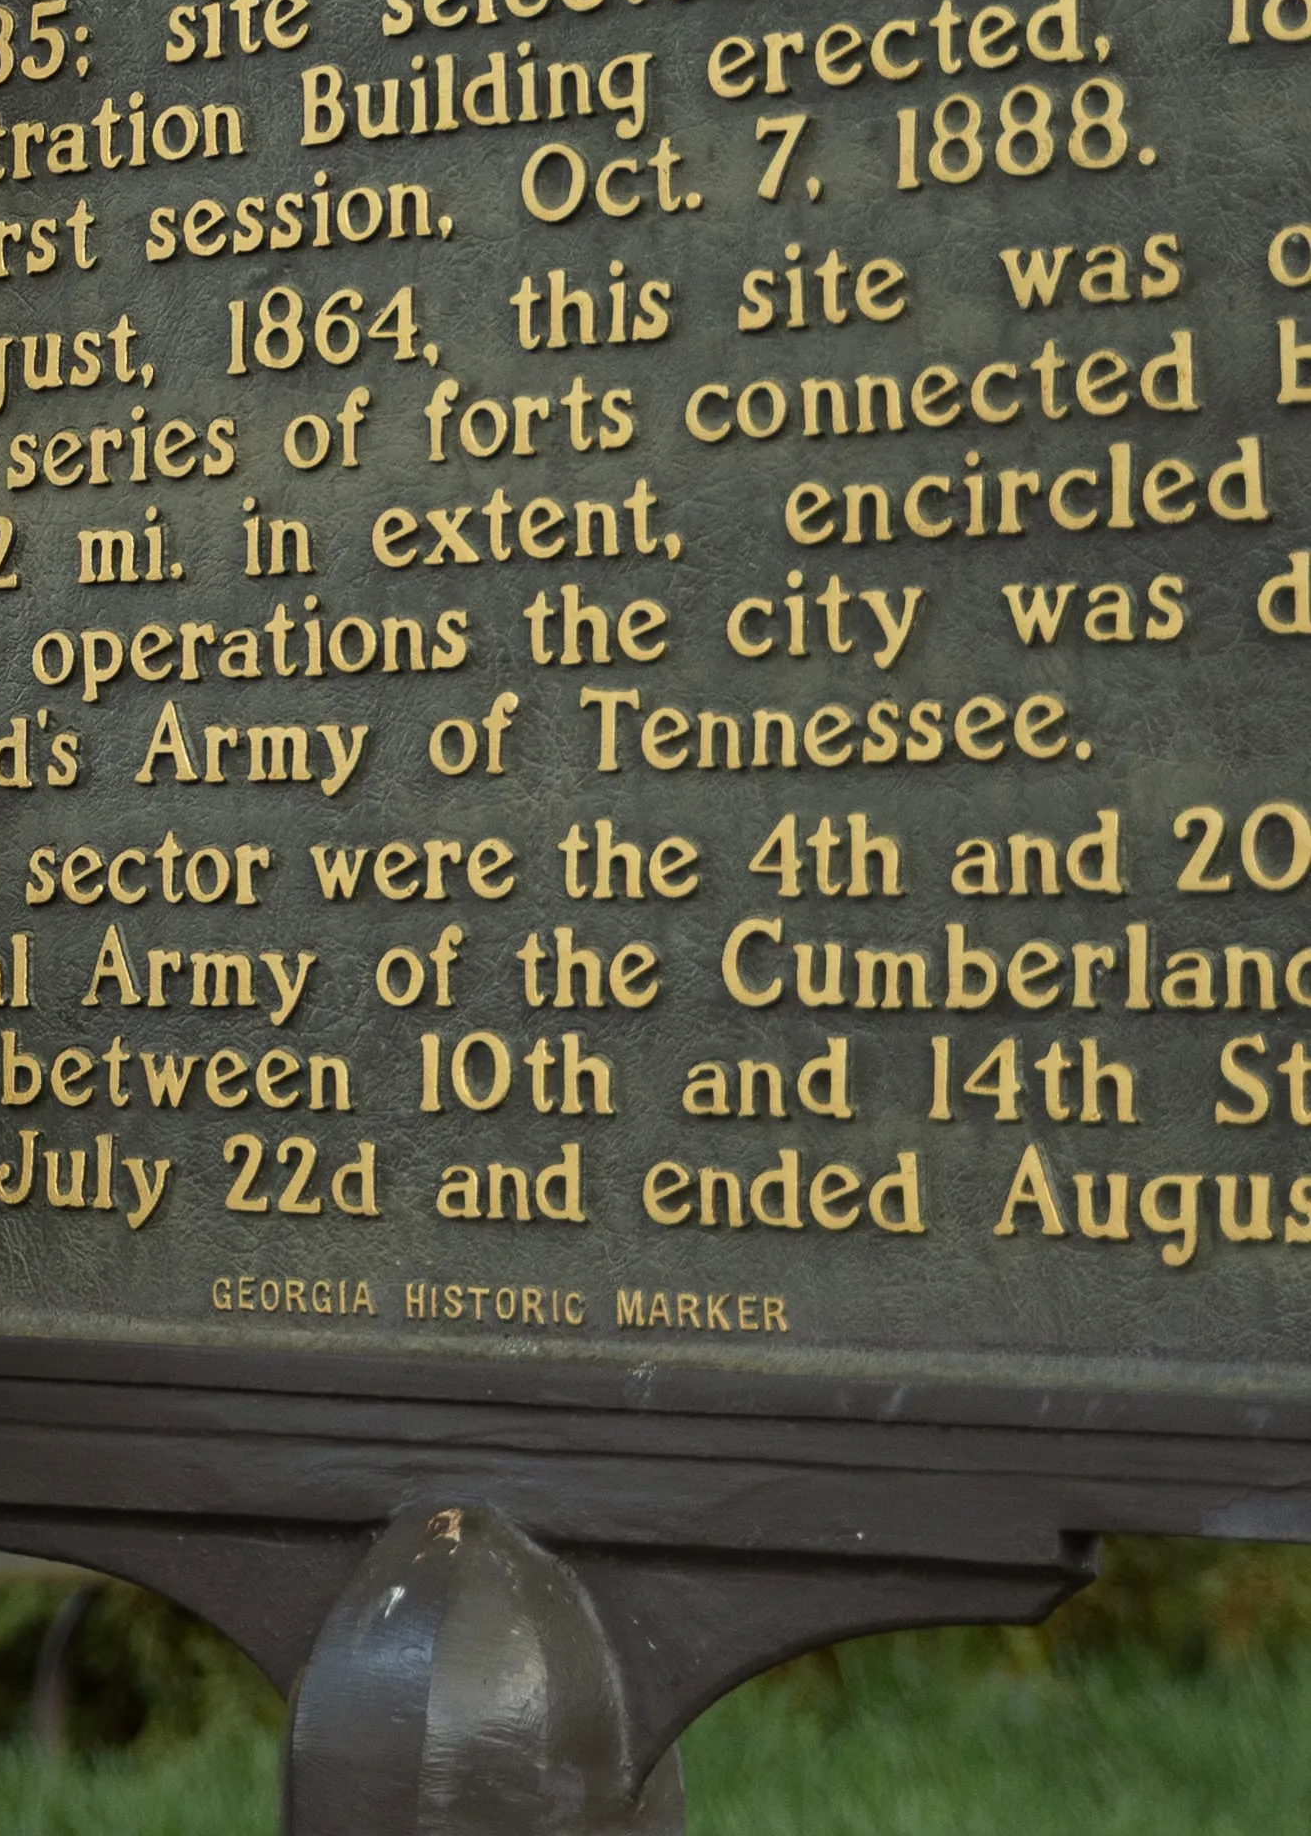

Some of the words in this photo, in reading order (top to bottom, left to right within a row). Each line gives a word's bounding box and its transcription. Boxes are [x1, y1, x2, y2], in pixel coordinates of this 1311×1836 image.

[299, 39, 654, 147] Building
[144, 169, 454, 262] session,
[520, 135, 704, 223] Oct.
[754, 111, 822, 200] 7,
[895, 75, 1158, 191] 1888.
[226, 283, 440, 376] 1864,
[507, 258, 672, 351] this
[736, 241, 906, 332] site
[999, 232, 1182, 310] was
[5, 403, 236, 491] series
[282, 384, 371, 470] of
[423, 373, 635, 463] forts
[683, 327, 1200, 443] connected
[75, 503, 185, 585] mi.
[241, 494, 313, 577] in
[370, 476, 684, 569] extent,
[783, 434, 1270, 546] encircled
[31, 593, 469, 703] operations
[521, 582, 668, 666] the
[725, 568, 924, 670] city
[1000, 573, 1185, 645] was
[133, 698, 370, 798] Army
[427, 690, 521, 776] of
[578, 684, 1093, 773] Tennessee.
[24, 829, 271, 906] sector
[308, 836, 516, 901] were
[556, 817, 700, 900] the
[747, 810, 904, 898] 4th
[949, 806, 1124, 896] and
[80, 922, 318, 1027] Army
[374, 922, 465, 1008] of
[514, 924, 660, 1009] the
[0, 1028, 352, 1112] between
[418, 1029, 615, 1115] 10th
[680, 1034, 854, 1120] and
[927, 1033, 1138, 1124] 14th
[221, 1131, 381, 1217] 22d
[435, 1141, 587, 1223] and
[641, 1146, 927, 1234] ended
[211, 1275, 378, 1316] GEORGIA
[405, 1282, 586, 1326] HISTORIC
[616, 1288, 790, 1333] MARKER
